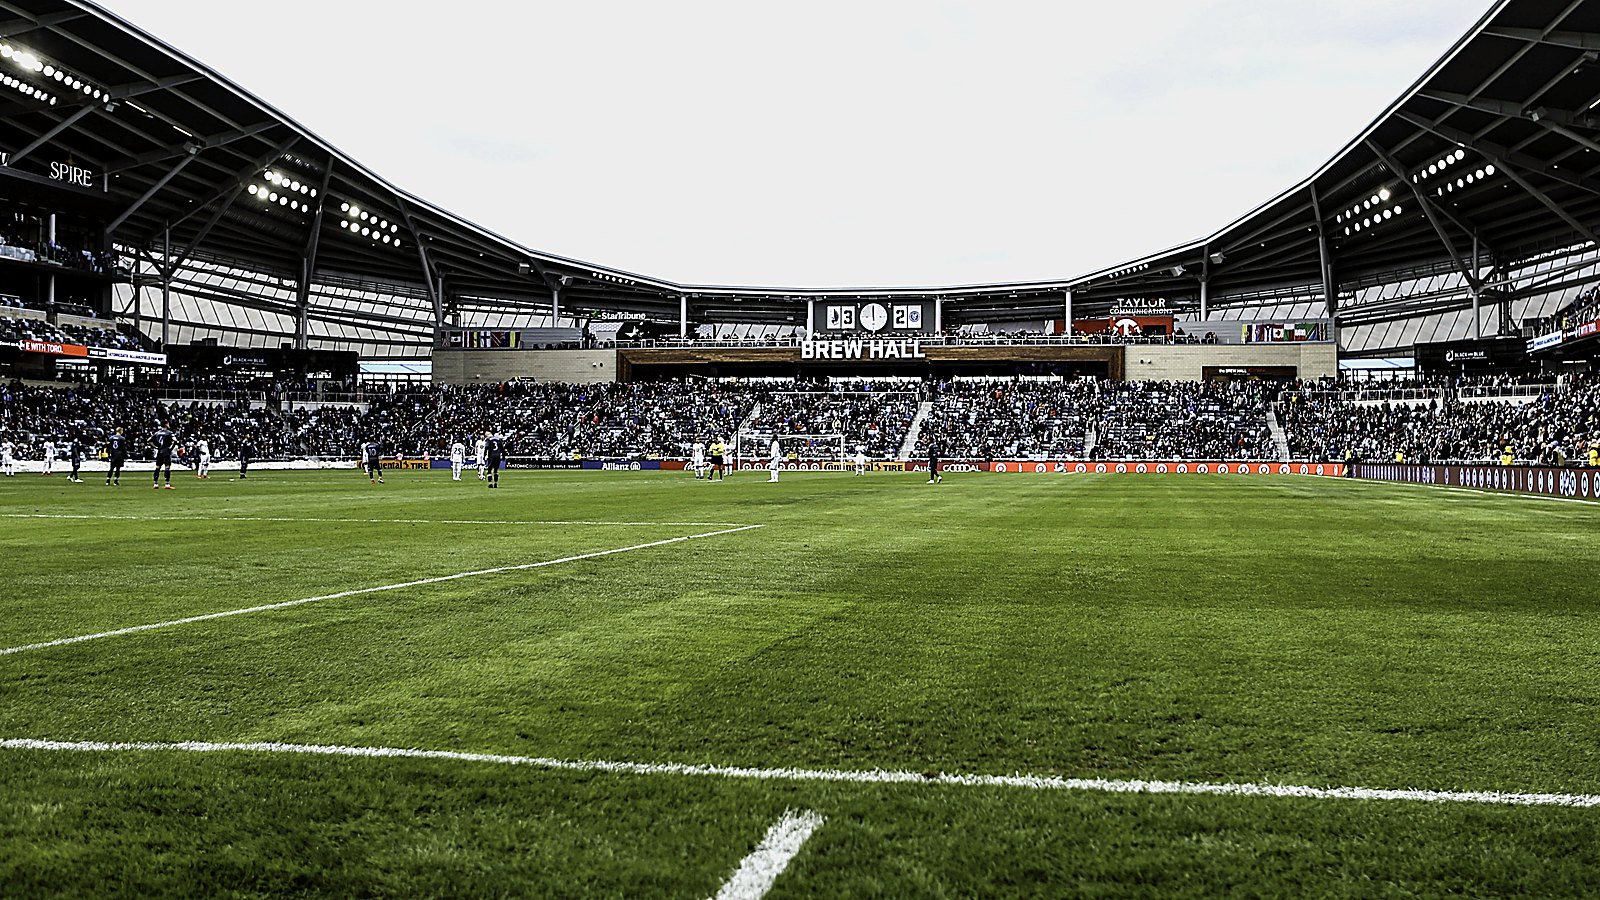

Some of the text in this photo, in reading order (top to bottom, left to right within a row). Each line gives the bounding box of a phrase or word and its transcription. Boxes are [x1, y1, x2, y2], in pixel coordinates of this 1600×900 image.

[50, 161, 92, 187] SPIRE
[1117, 298, 1166, 307] TAYLOR
[843, 310, 853, 325] 3
[895, 310, 905, 325] 2
[31, 343, 46, 352] WITH
[801, 339, 926, 359] BREW HALL
[492, 441, 499, 451] 3
[410, 462, 429, 470] TIRE
[602, 462, 630, 471] Allianz
[882, 464, 903, 472] TIRE
[912, 463, 932, 472] Aud
